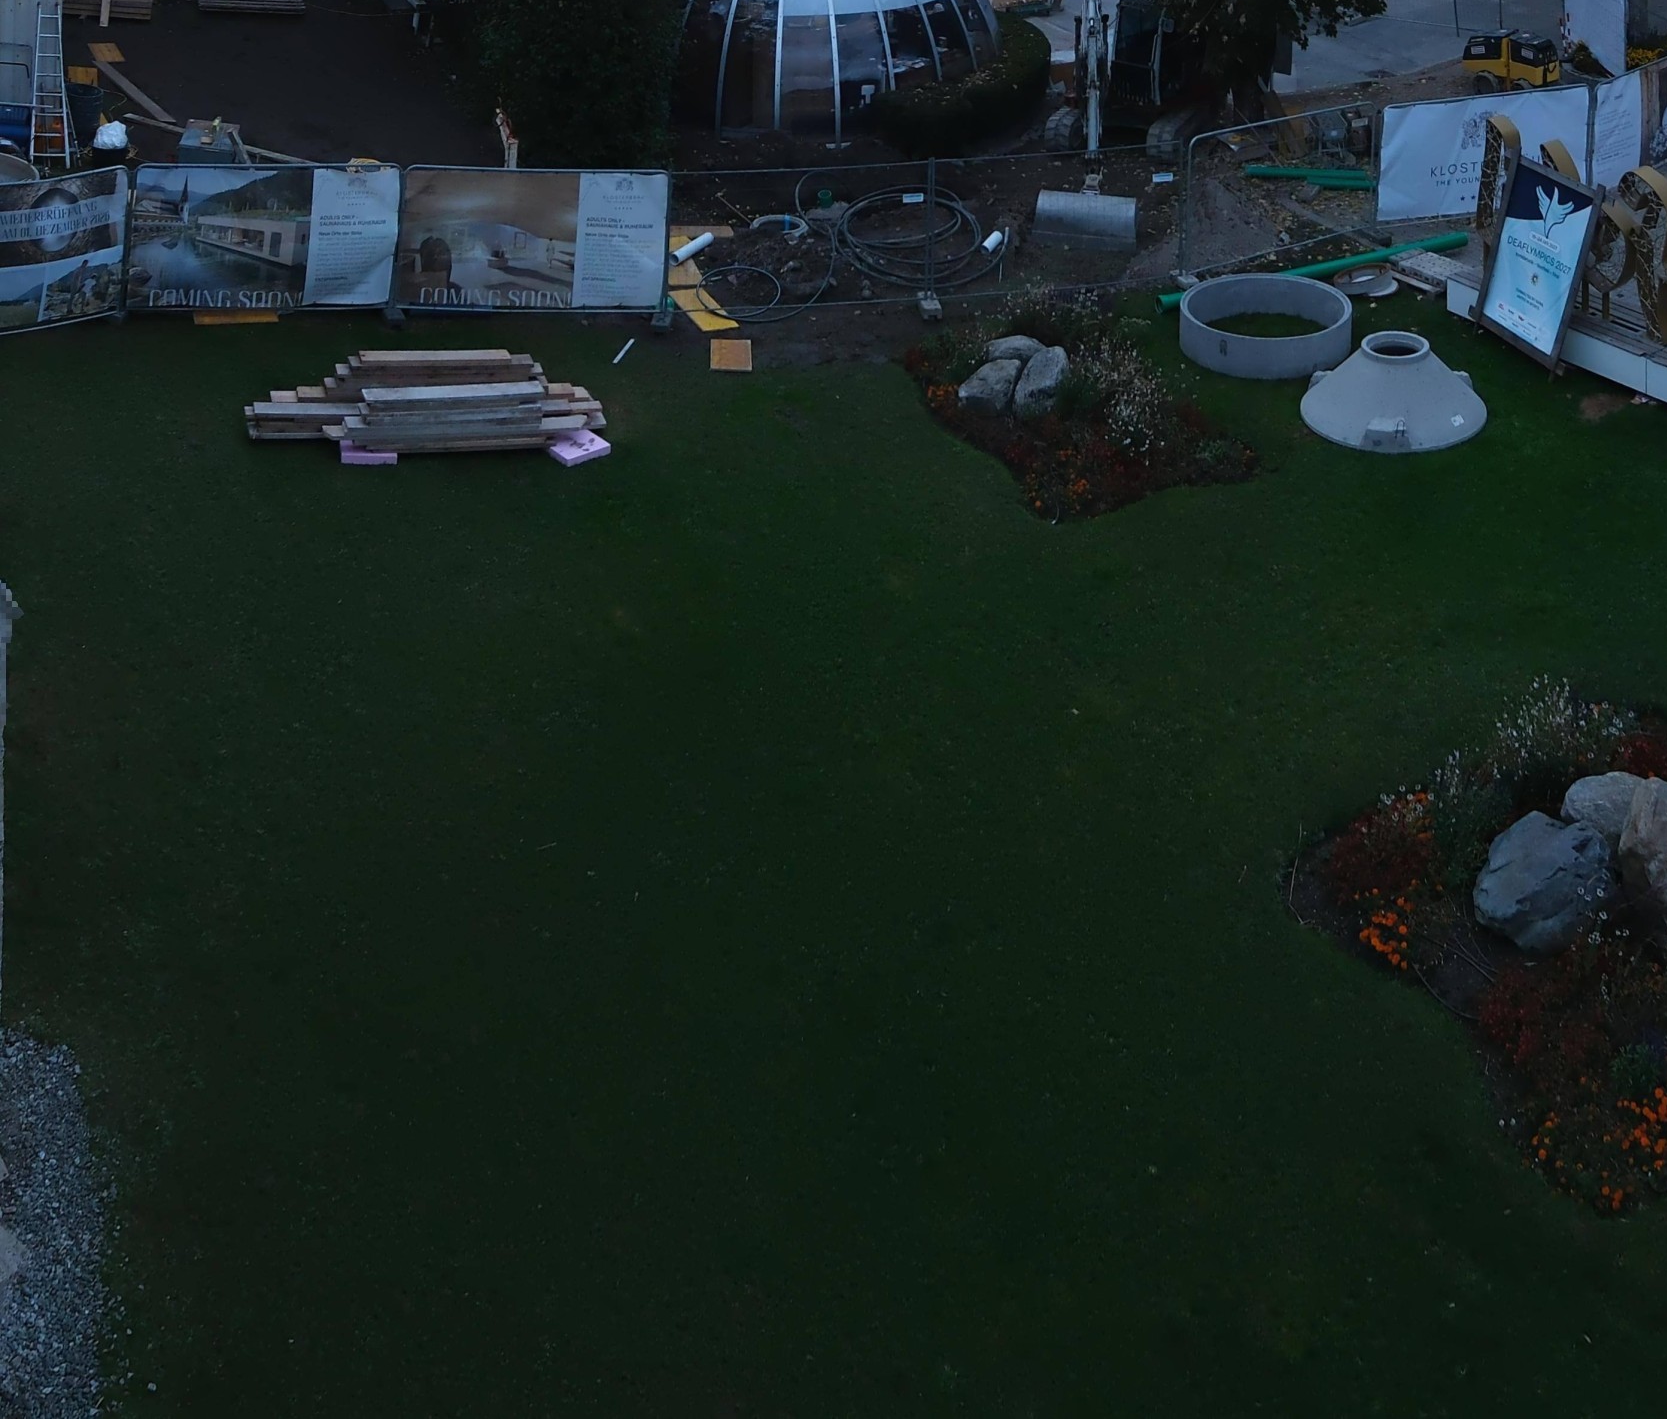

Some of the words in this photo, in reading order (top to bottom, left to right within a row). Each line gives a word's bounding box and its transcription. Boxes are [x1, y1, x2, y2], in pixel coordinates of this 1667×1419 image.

[1436, 179, 1450, 187] THE
[36, 220, 87, 236] DEZEMBER
[1507, 236, 1555, 266] DEAFLYMPICS
[1555, 260, 1571, 274] 2027
[149, 288, 230, 308] COMING
[420, 287, 500, 308] COMING
